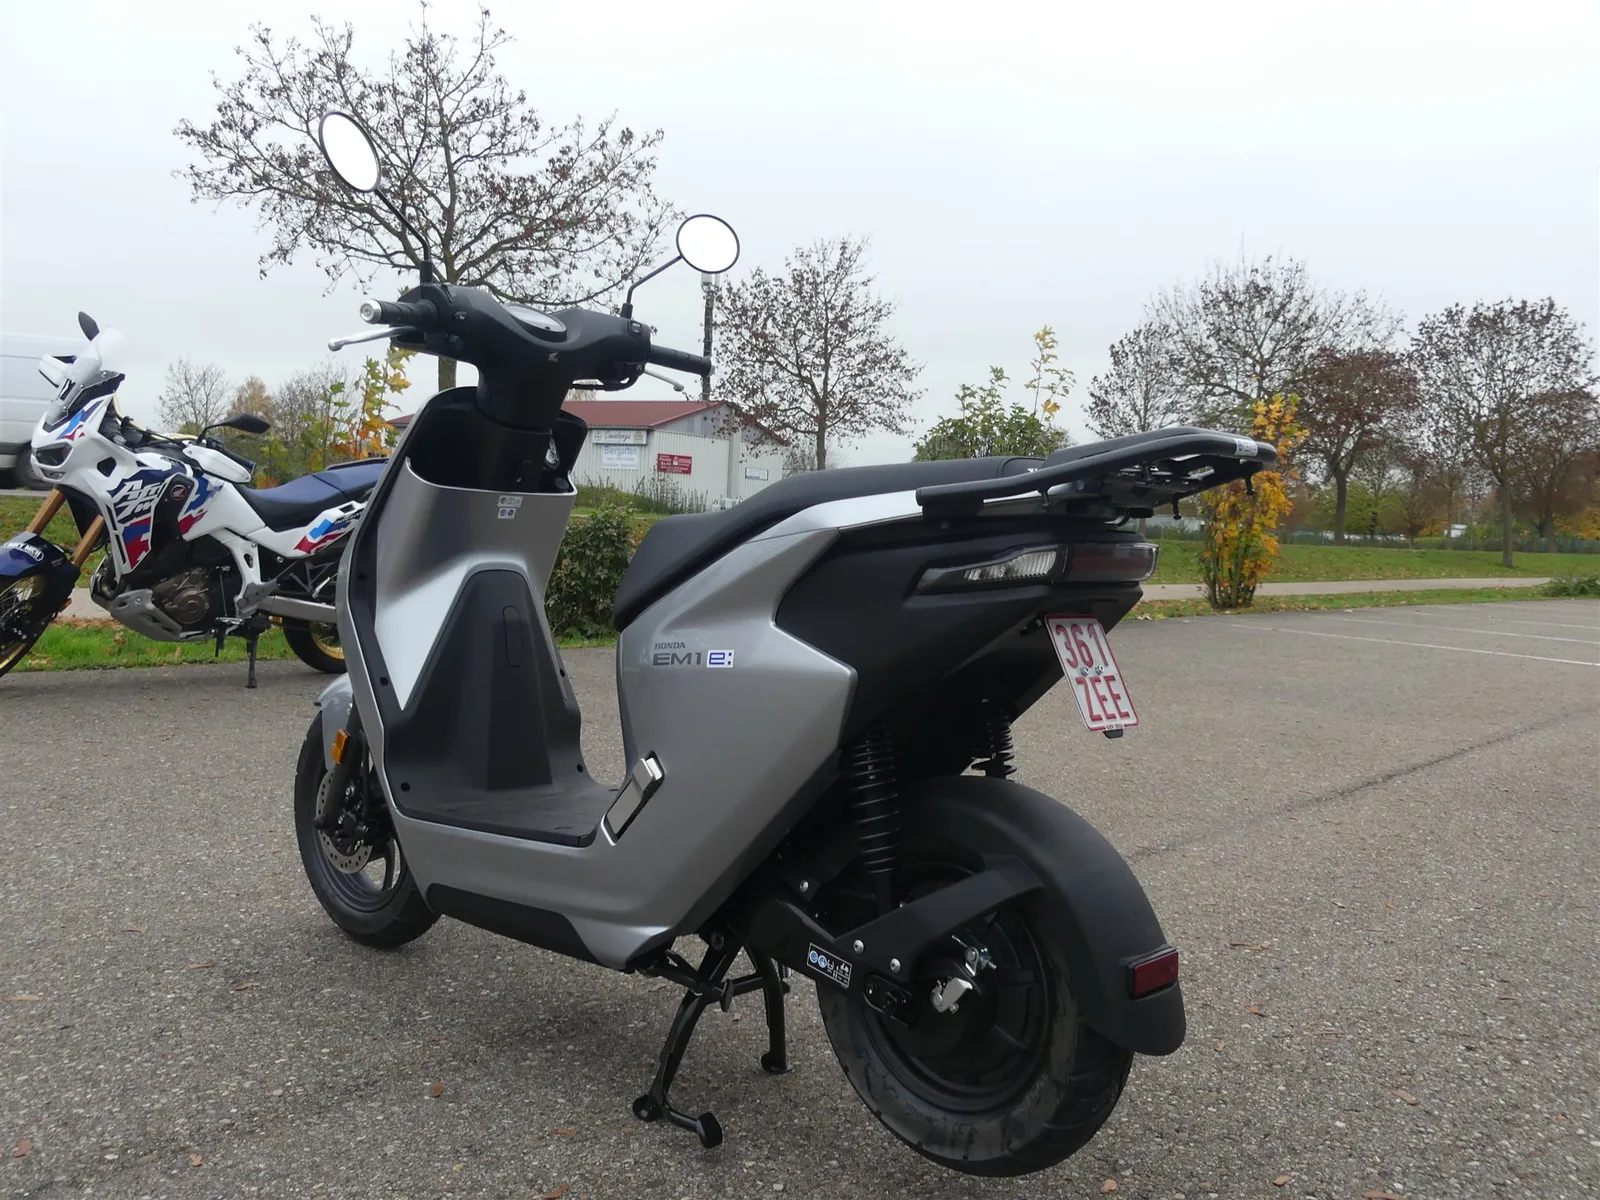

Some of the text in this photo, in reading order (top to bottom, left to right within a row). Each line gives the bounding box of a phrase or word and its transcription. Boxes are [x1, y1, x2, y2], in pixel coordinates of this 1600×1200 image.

[604, 445, 638, 456] Biergarten
[654, 642, 686, 650] HONDA
[1055, 623, 1109, 669] 361
[652, 652, 702, 666] EM1
[1075, 675, 1130, 722] ZEE
